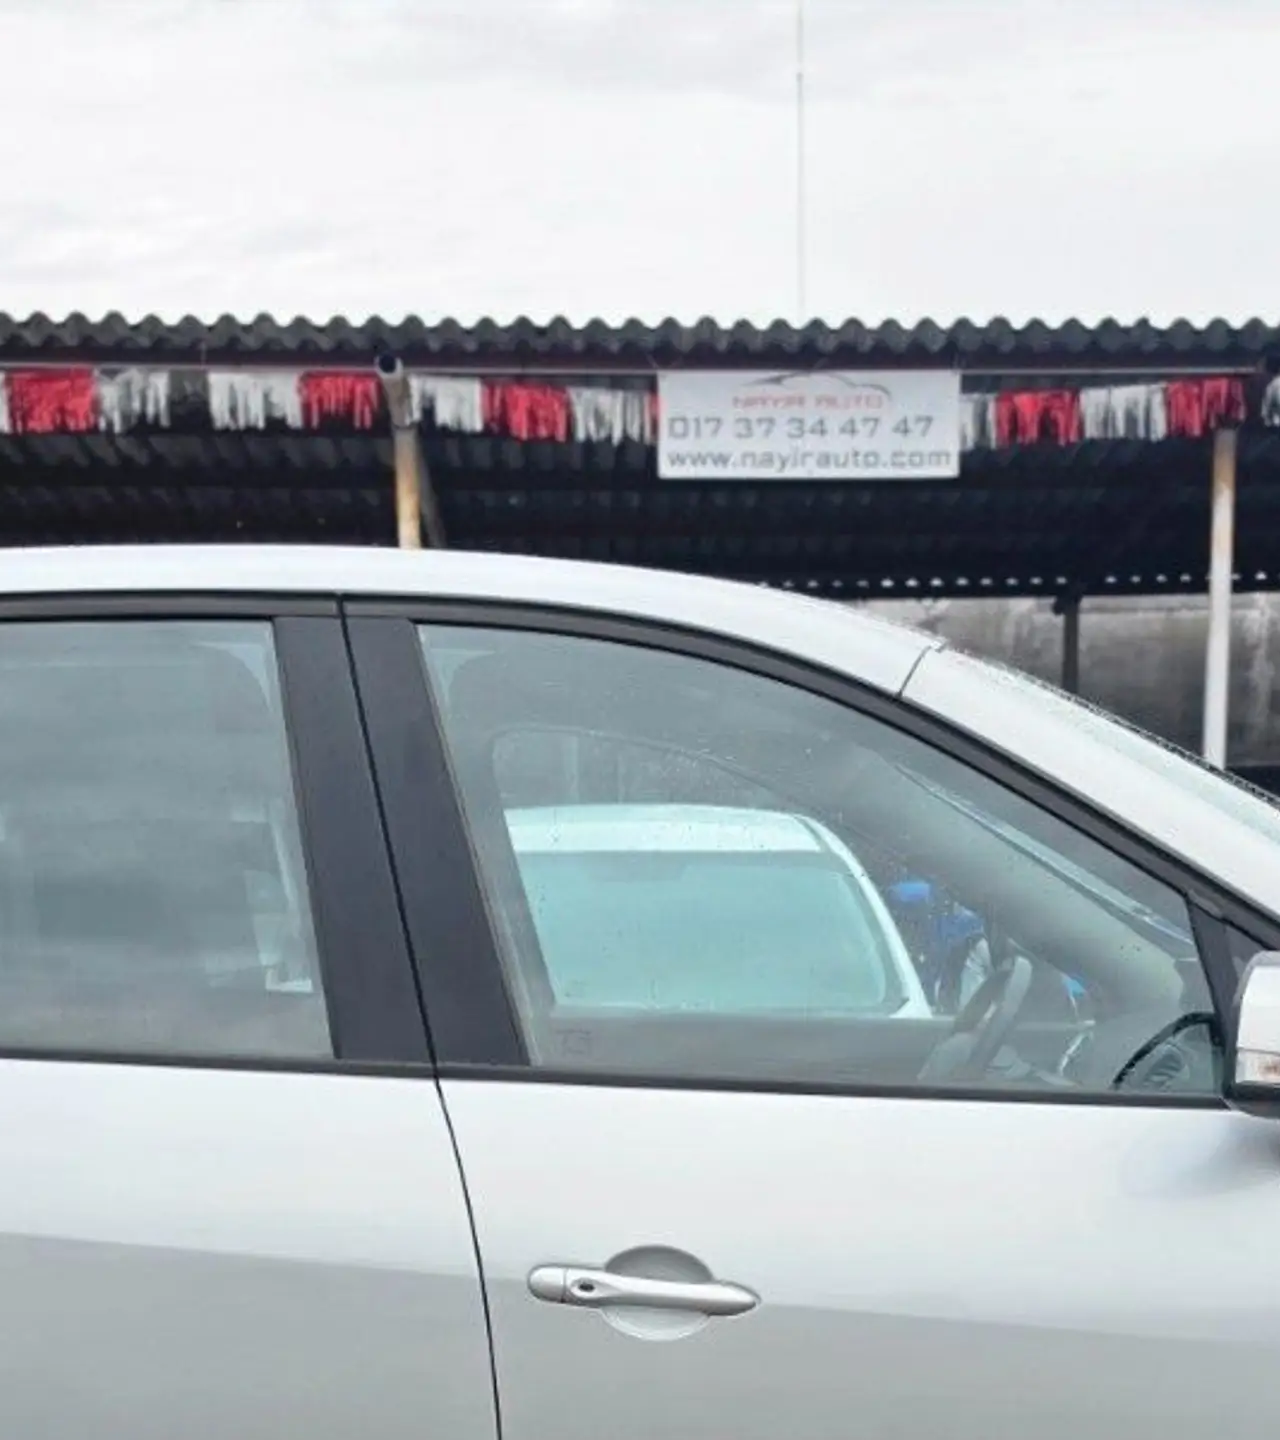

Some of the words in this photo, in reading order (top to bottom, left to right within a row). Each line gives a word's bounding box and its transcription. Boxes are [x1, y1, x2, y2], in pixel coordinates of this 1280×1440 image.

[668, 416, 722, 439] 017
[734, 416, 776, 439] 37
[786, 416, 828, 438] 34
[838, 416, 880, 438] 47
[892, 415, 934, 437] 47
[669, 447, 951, 472] www.nayirauto.com
